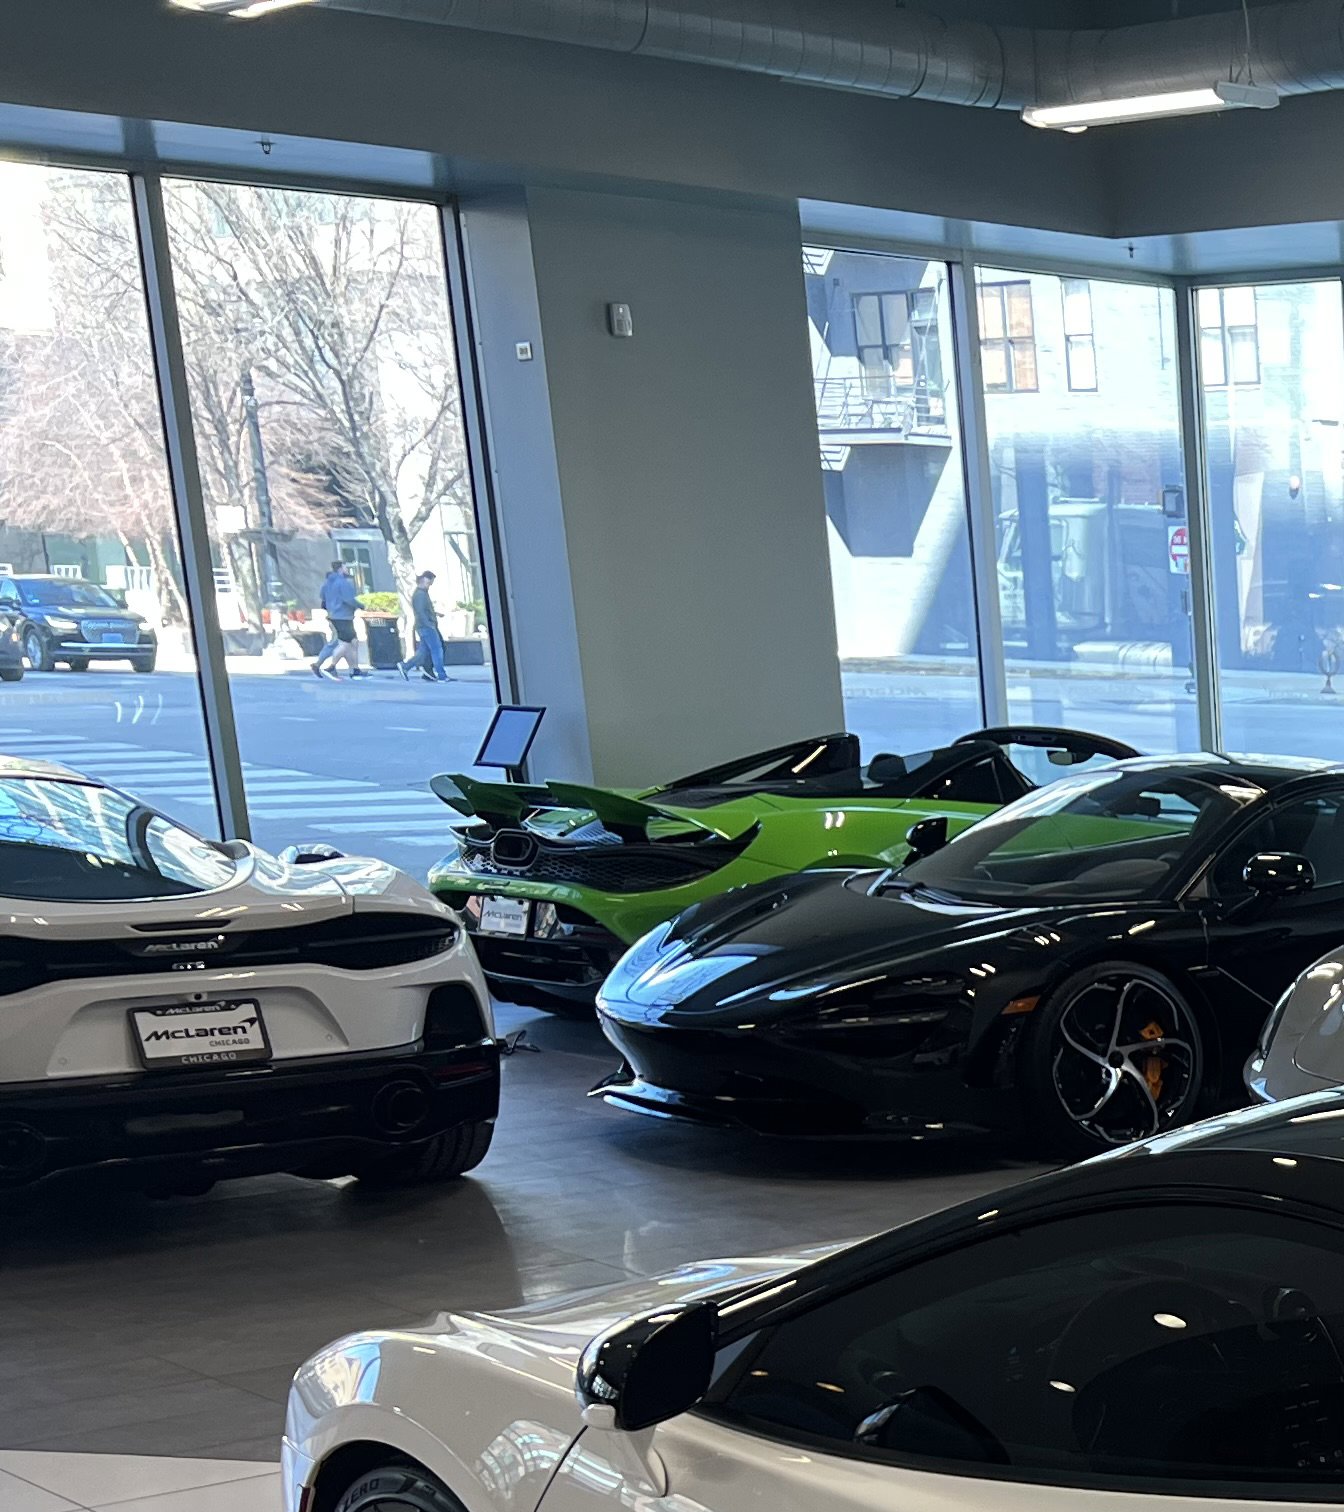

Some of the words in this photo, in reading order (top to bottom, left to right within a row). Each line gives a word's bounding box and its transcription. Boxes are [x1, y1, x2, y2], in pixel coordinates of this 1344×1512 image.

[165, 1005, 220, 1015] McLaren
[144, 1025, 247, 1041] McLaren
[209, 1037, 250, 1048] CHICAGO
[181, 1052, 237, 1065] CHICAGO
